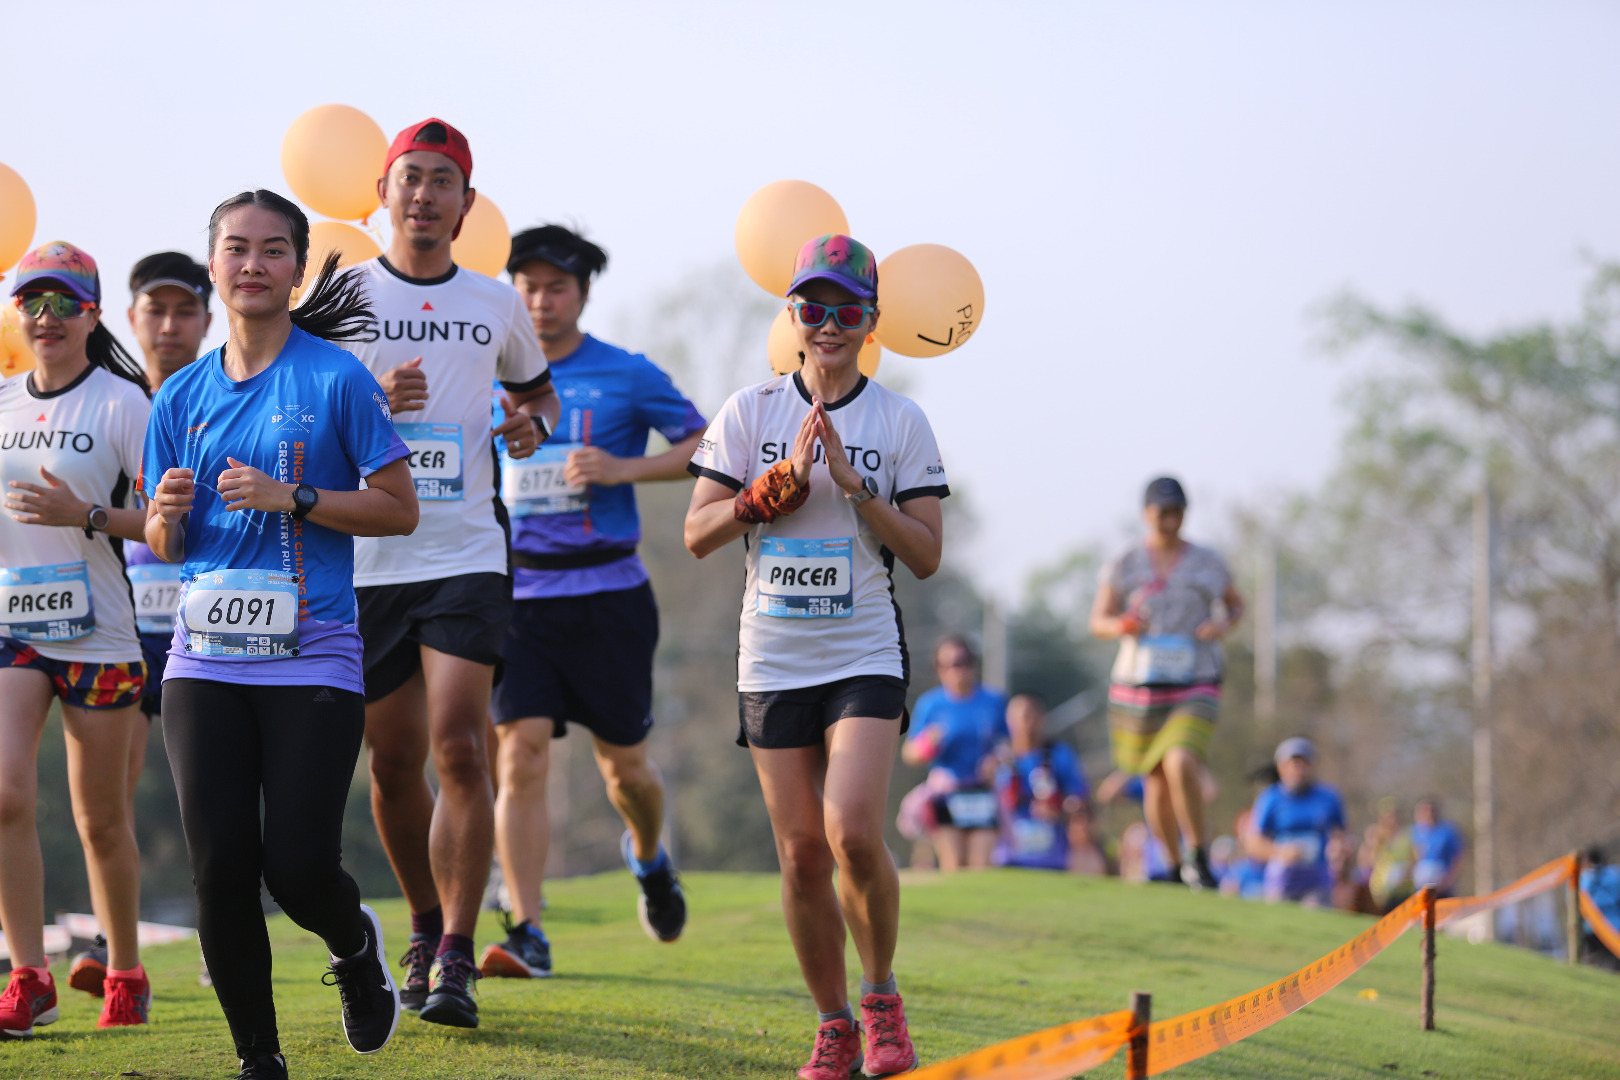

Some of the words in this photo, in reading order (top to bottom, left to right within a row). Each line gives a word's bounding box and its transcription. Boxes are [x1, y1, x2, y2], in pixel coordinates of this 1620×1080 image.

[363, 319, 491, 345] SUUNTO
[271, 414, 284, 423] SP
[301, 414, 315, 423] XC
[0, 430, 94, 454] UUNTO
[278, 440, 288, 483] CROSS
[293, 441, 305, 484] SINGH
[407, 450, 446, 469] CER
[770, 566, 838, 587] PACER
[8, 590, 73, 614] PACER
[142, 587, 179, 610] 617
[831, 602, 844, 615] 16
[207, 596, 275, 626] 6091
[70, 623, 84, 636] 16
[272, 642, 286, 656] 16
